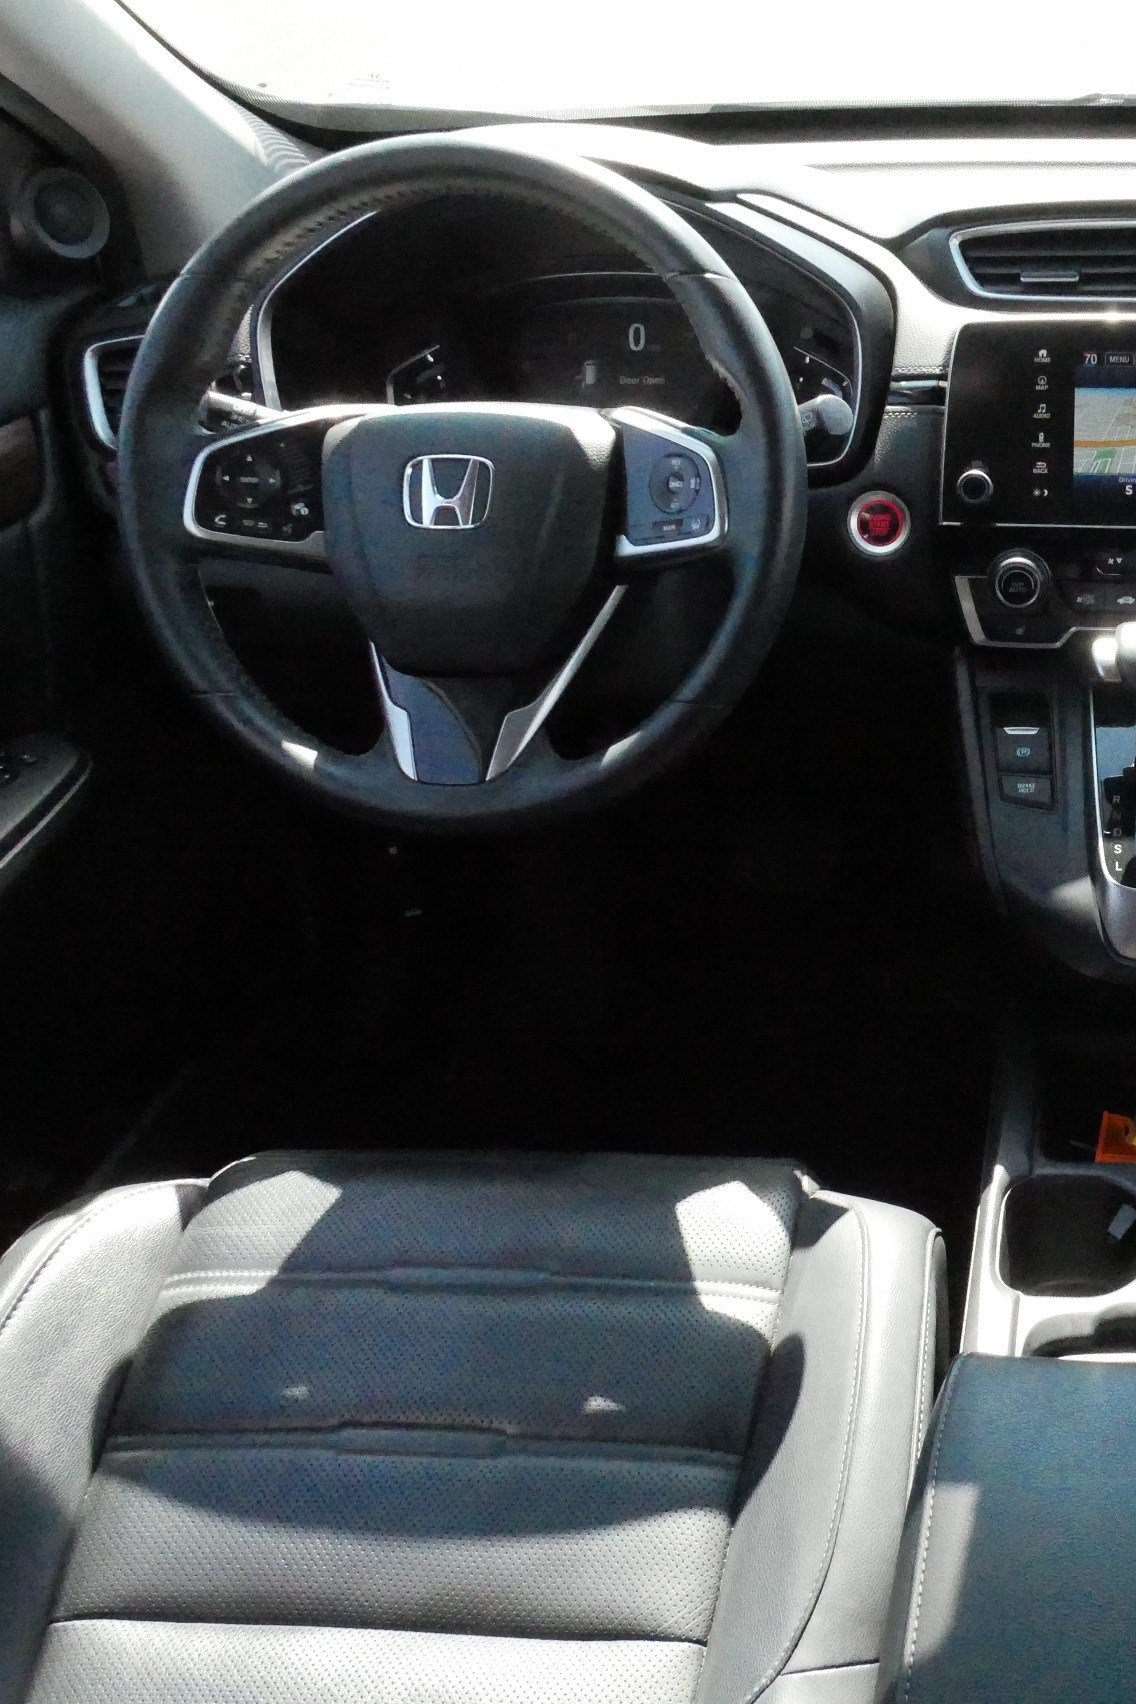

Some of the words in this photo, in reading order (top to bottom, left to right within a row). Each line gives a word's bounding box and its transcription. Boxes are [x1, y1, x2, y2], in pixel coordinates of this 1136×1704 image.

[1083, 353, 1098, 365] 70
[1109, 355, 1130, 364] MENU
[1125, 485, 1133, 496] S
[1113, 795, 1121, 803] R
[1114, 844, 1122, 854] S
[1115, 861, 1123, 872] L
